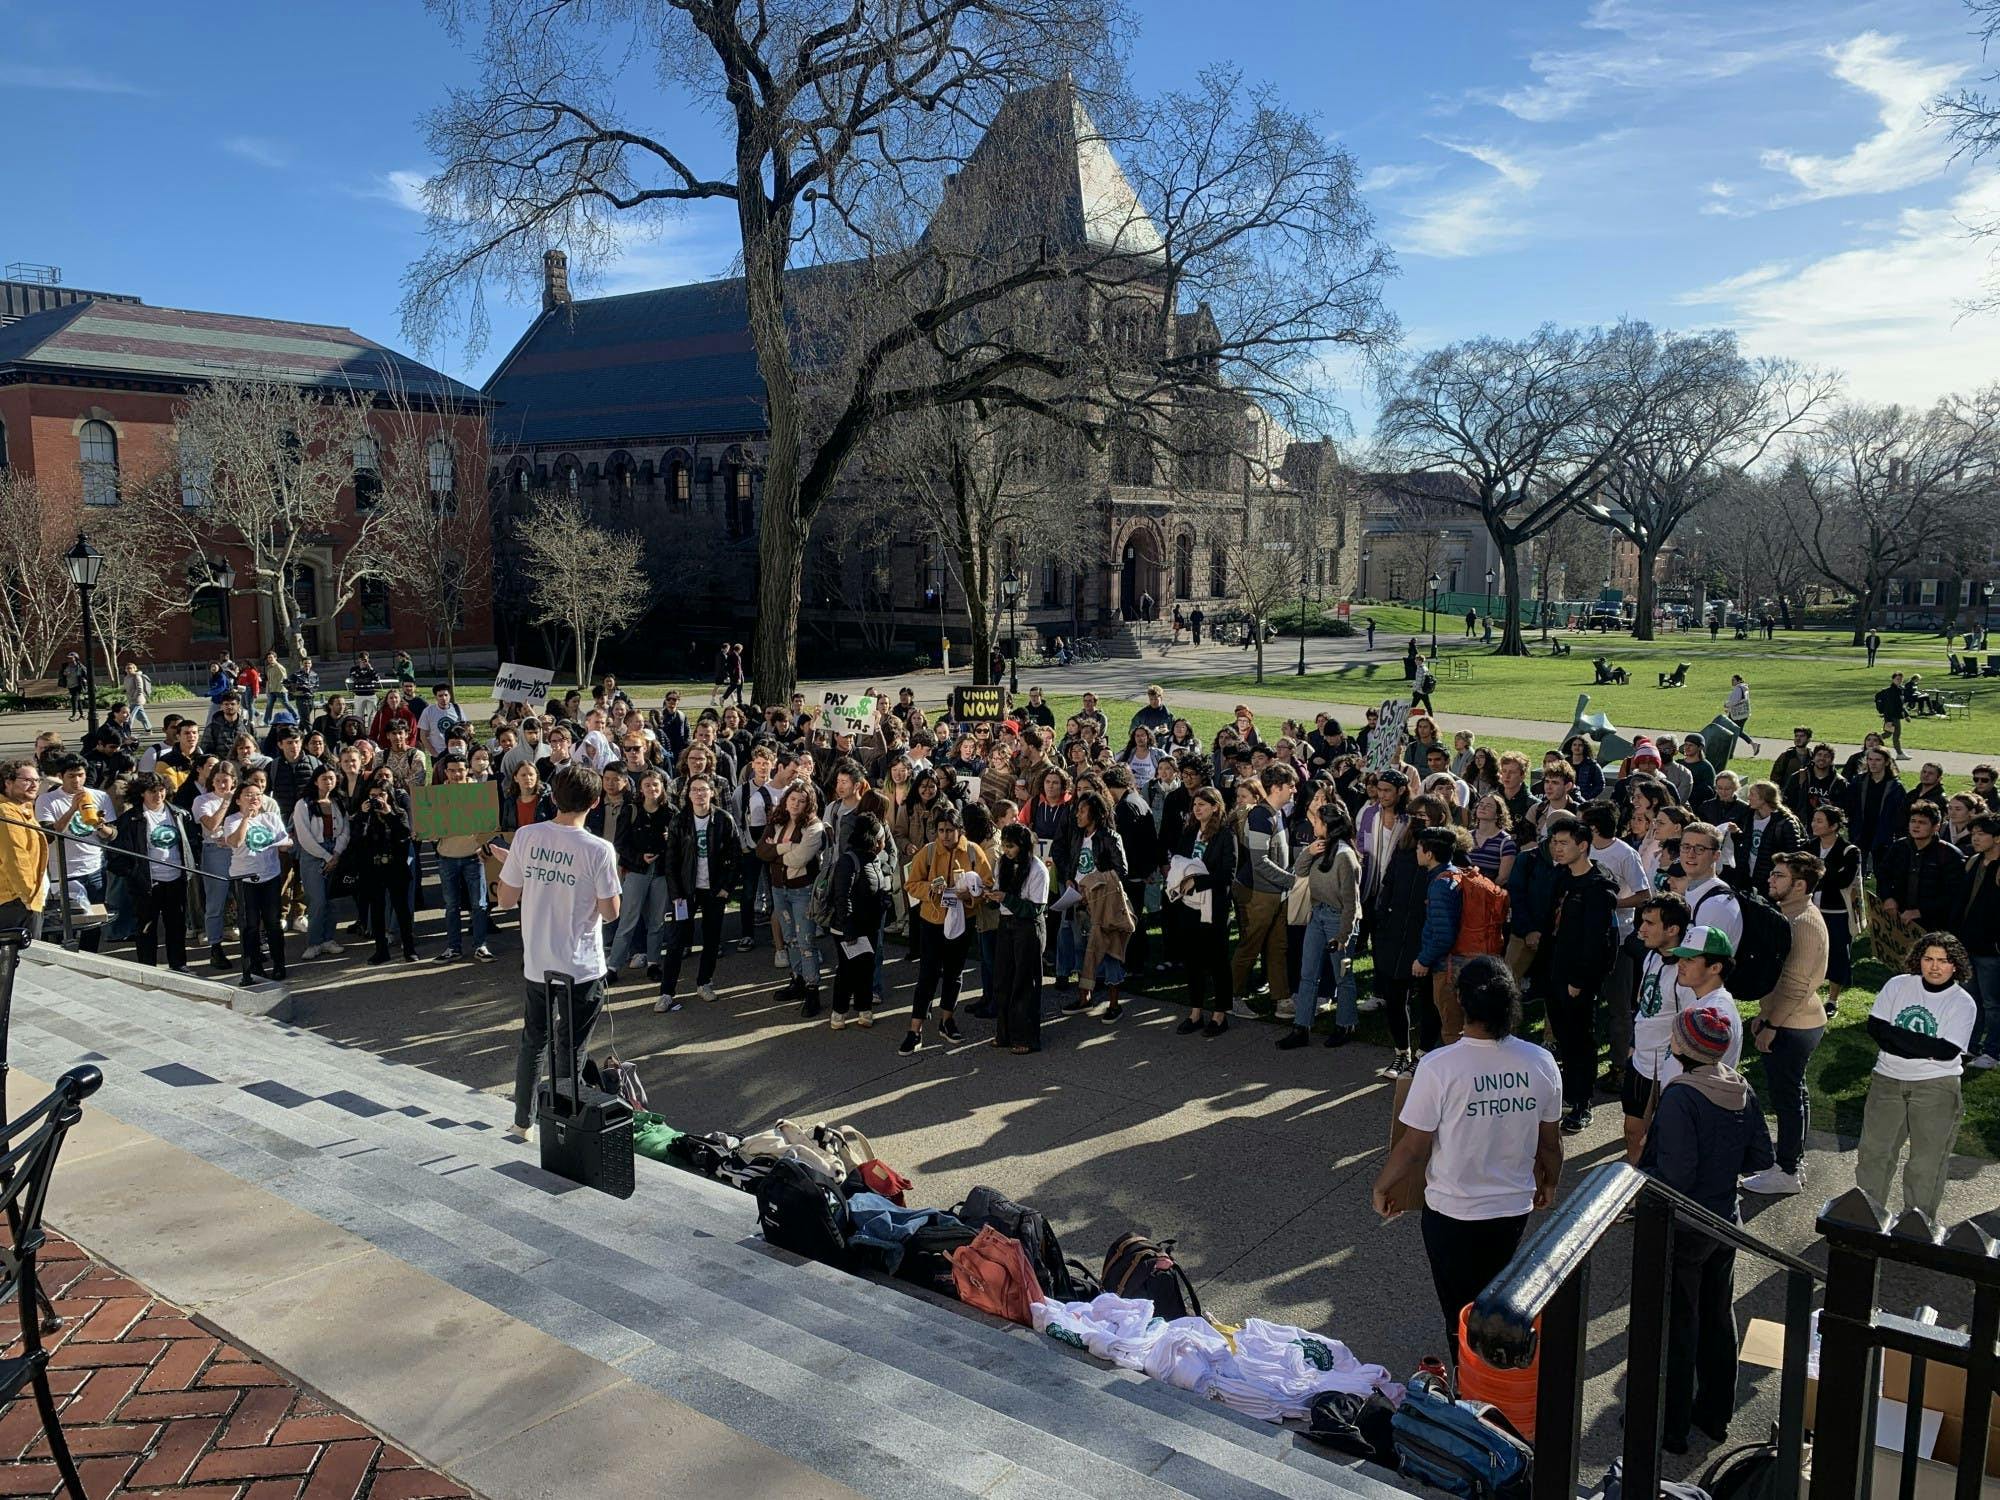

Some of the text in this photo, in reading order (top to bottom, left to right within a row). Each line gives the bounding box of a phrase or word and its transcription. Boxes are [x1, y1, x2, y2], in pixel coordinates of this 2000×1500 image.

[823, 692, 848, 706] PAY
[962, 690, 999, 700] UNION
[834, 706, 856, 718] OUR
[963, 702, 1000, 717] NOW
[845, 717, 870, 733] TAS
[530, 846, 574, 867] UNION
[525, 865, 576, 886] STRONG
[1474, 1071, 1529, 1093] UNION
[1466, 1096, 1537, 1117] STRONG
